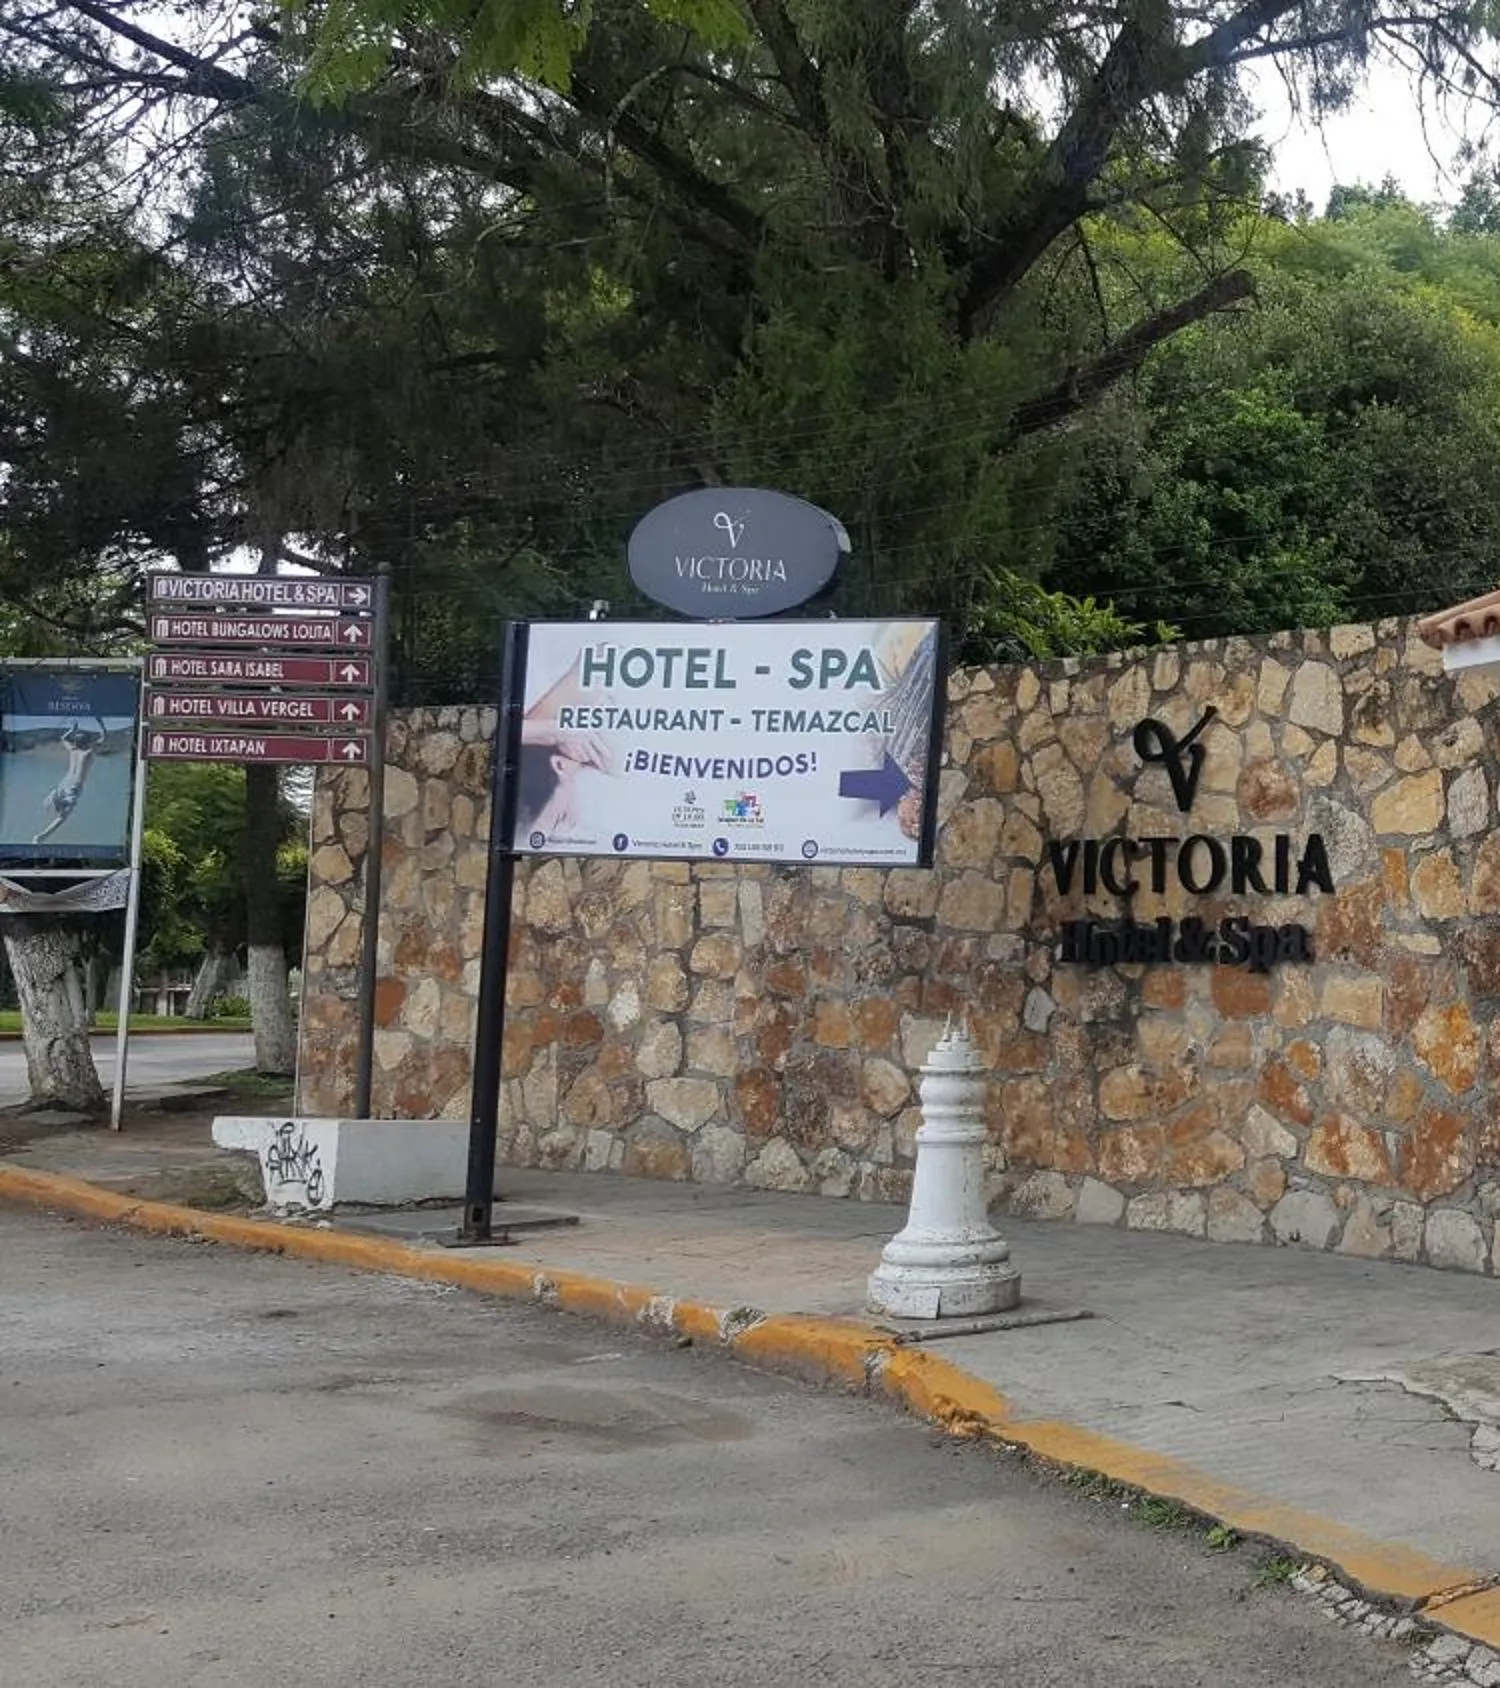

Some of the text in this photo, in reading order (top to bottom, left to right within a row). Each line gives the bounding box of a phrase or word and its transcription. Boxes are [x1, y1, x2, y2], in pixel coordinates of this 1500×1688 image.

[675, 556, 787, 582] VICTORIA
[169, 580, 239, 601] VICTORIA
[242, 582, 291, 602] HOTEL
[172, 621, 208, 637] HOTEL
[212, 621, 290, 638] BUNGALOWS
[171, 658, 284, 678] HOTEL SARA ISABEL
[581, 647, 737, 690] HOTEL
[787, 648, 881, 690] SPA
[170, 698, 314, 717] HOTEL VILLA VERGEL
[559, 706, 725, 732] RESTAURANT
[751, 709, 896, 734] TEMAZCAL
[169, 737, 266, 754] HOTEL IXTAPAN
[624, 748, 818, 781] ¡BIENVENIDOS!
[1049, 834, 1336, 897] VICTORIA
